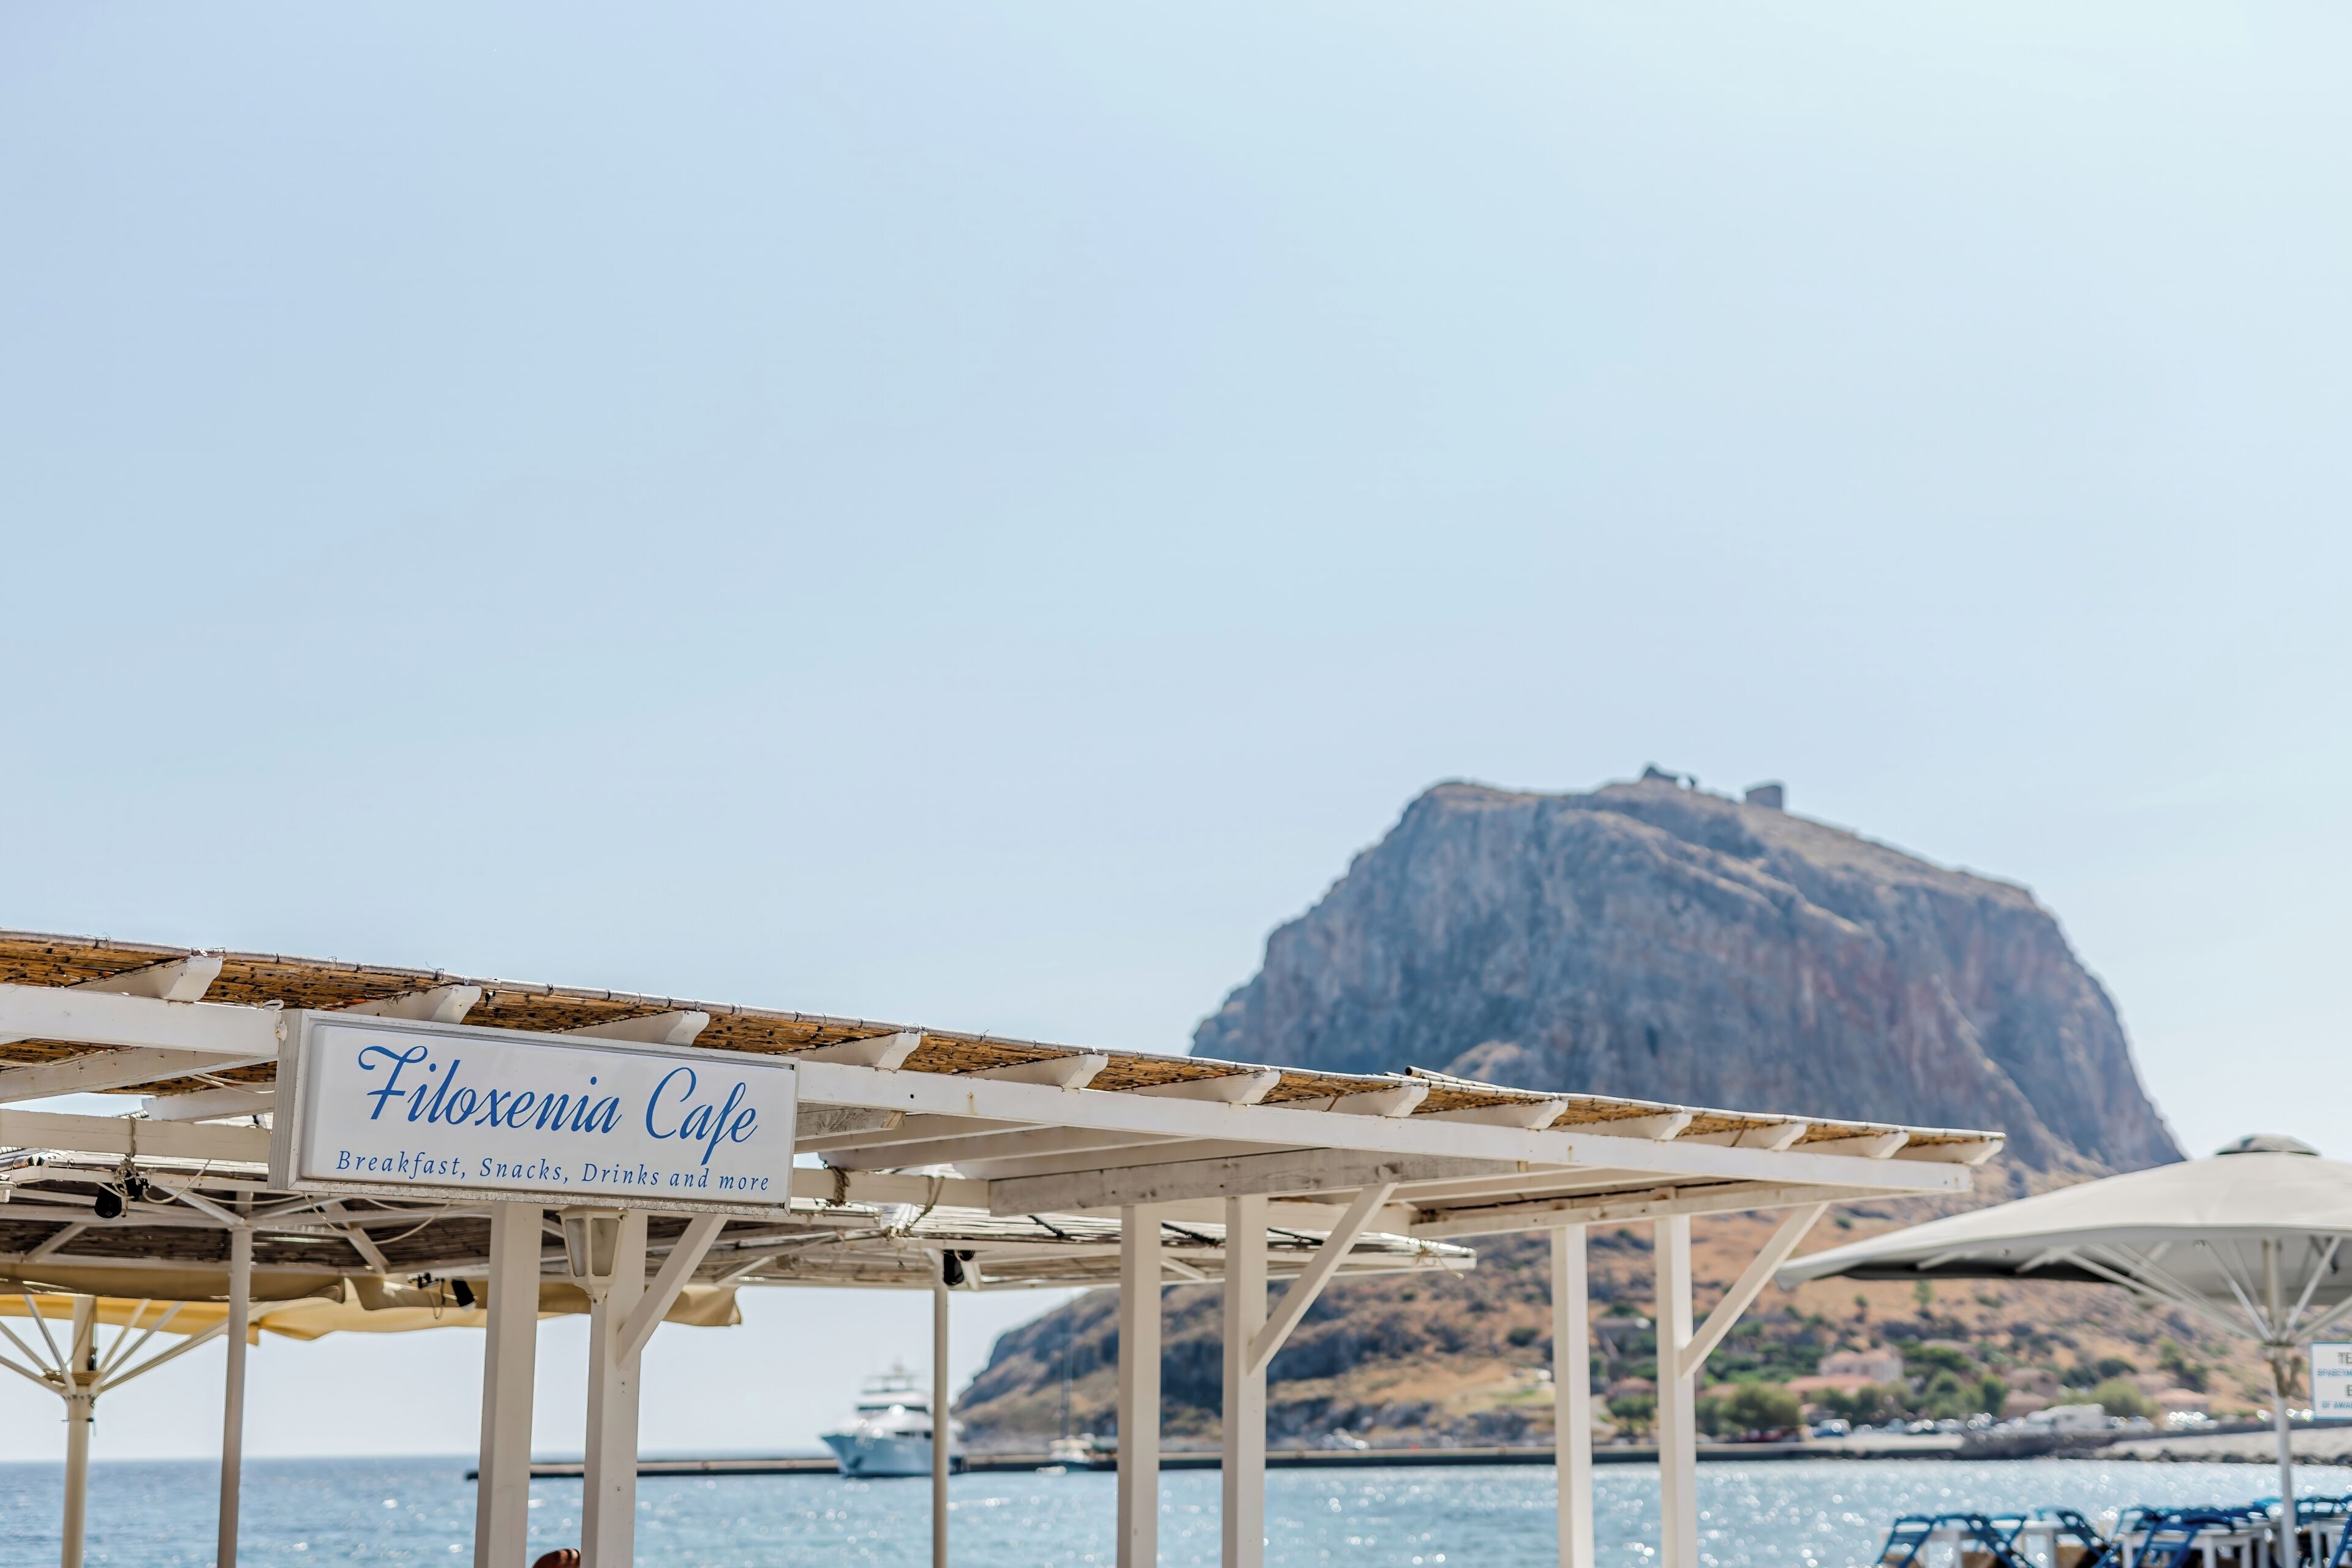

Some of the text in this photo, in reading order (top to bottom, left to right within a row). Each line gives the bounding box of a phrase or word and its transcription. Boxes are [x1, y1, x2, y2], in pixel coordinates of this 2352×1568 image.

[358, 1045, 757, 1166] Filoxenia Cafe
[336, 1150, 769, 1191] Breakfast, Snacks, Drinks and more
